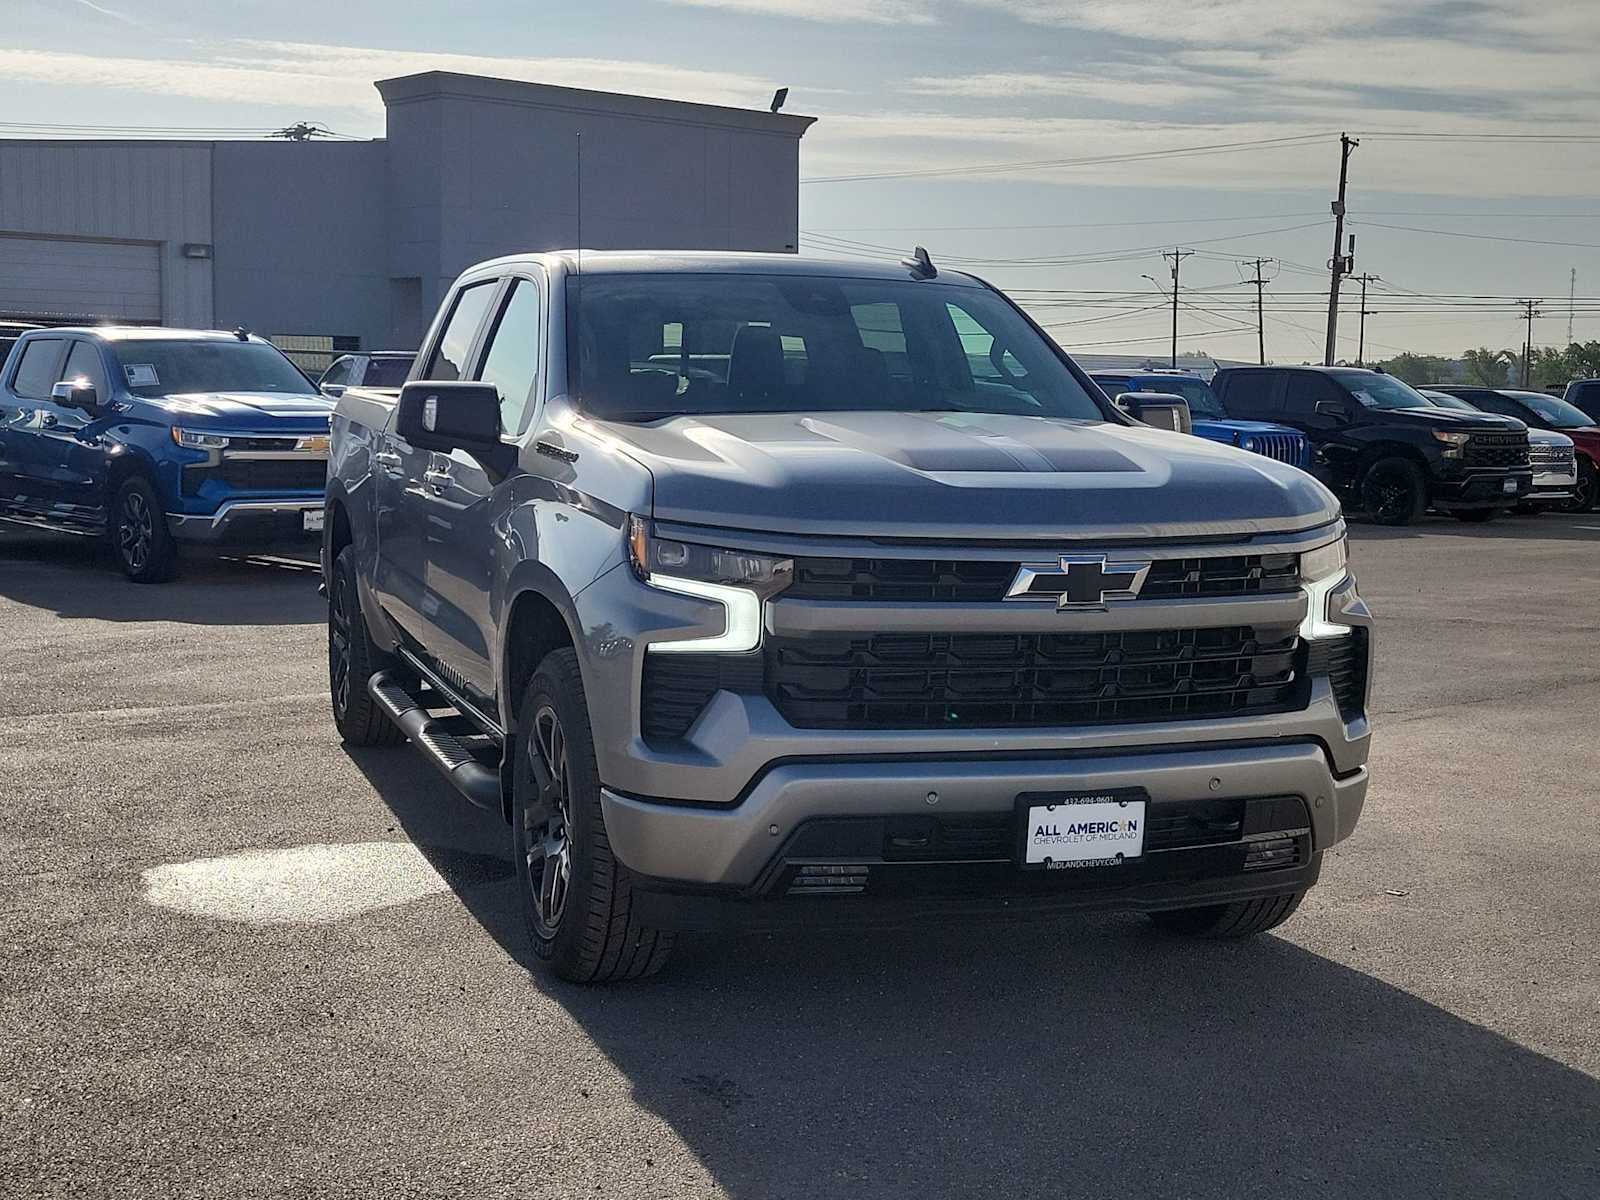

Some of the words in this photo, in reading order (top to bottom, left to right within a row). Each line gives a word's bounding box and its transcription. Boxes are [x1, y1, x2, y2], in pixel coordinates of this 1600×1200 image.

[1475, 434, 1527, 445] CHEVR
[1035, 824, 1061, 837] ALL
[1034, 834, 1085, 845] CHEVROLET
[1086, 834, 1098, 842] OF
[1099, 831, 1137, 841] MIDLAND
[1046, 858, 1122, 870] MIDLANDCHEVY.COM
